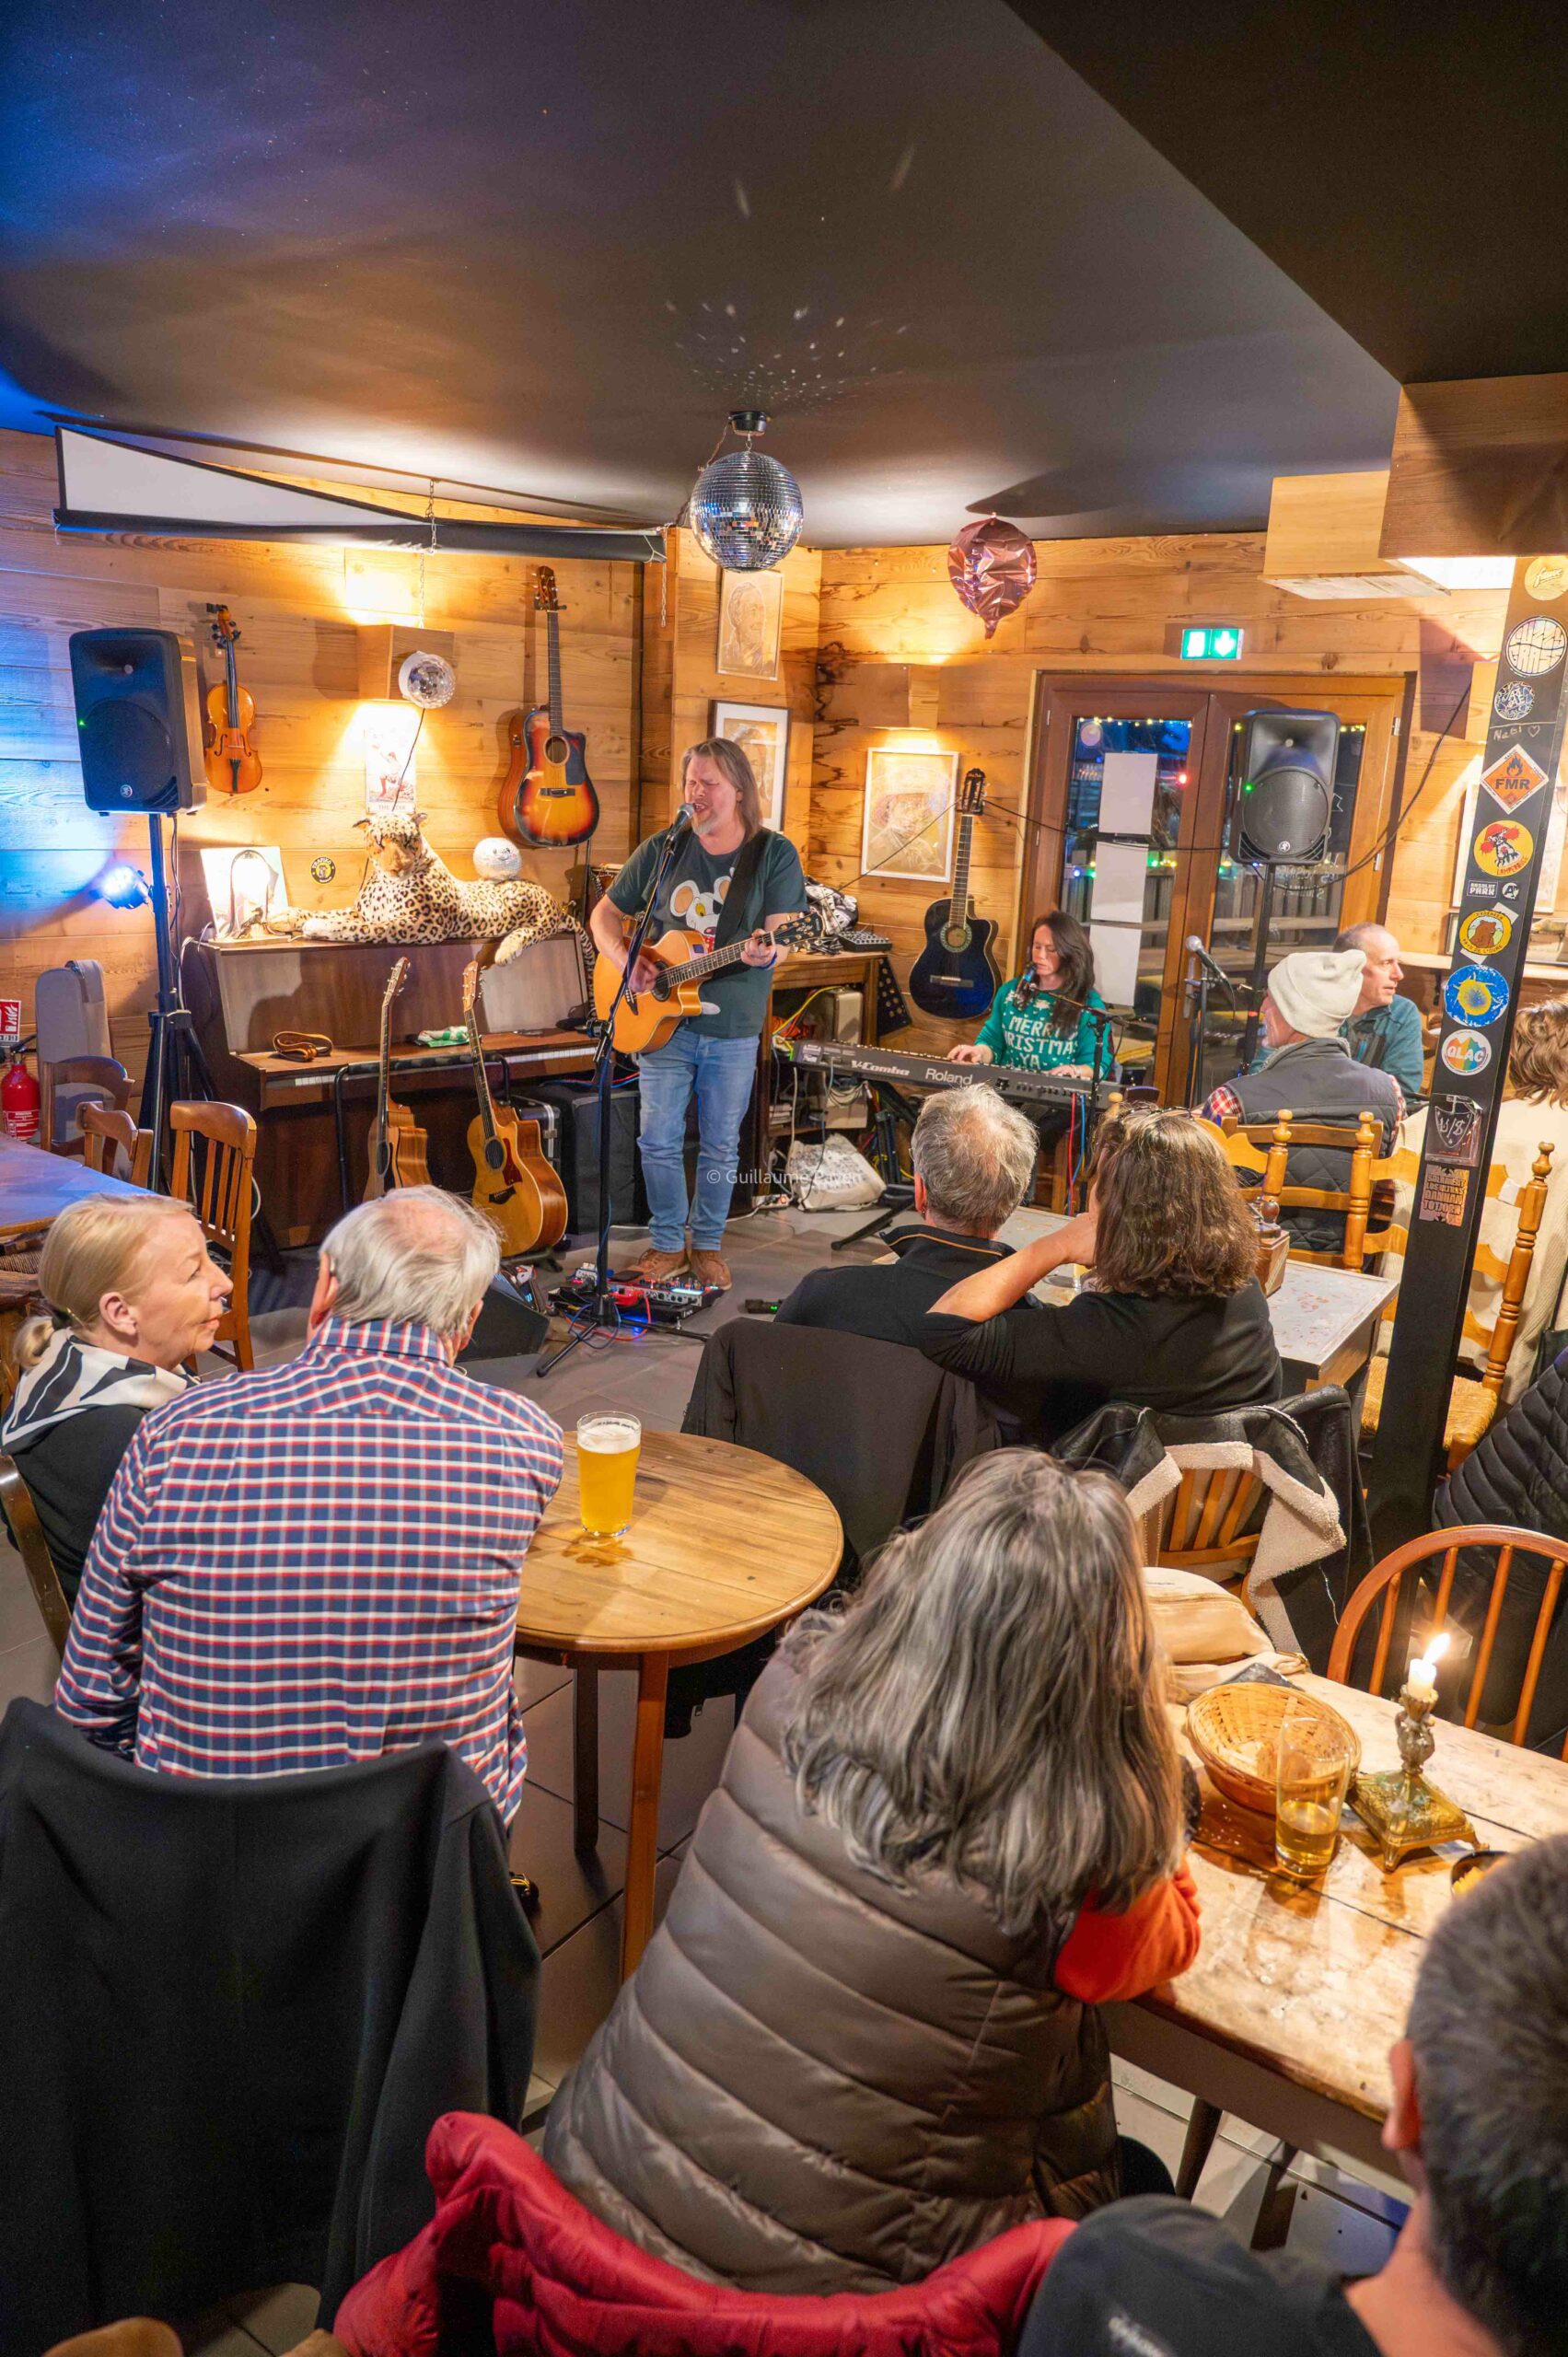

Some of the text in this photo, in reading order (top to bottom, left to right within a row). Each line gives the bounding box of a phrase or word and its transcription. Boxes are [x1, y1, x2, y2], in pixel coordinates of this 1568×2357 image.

[1495, 778, 1530, 790] FMR
[1469, 887, 1495, 896] PARK
[1019, 1052, 1041, 1070] YA
[925, 1068, 972, 1086] Roland
